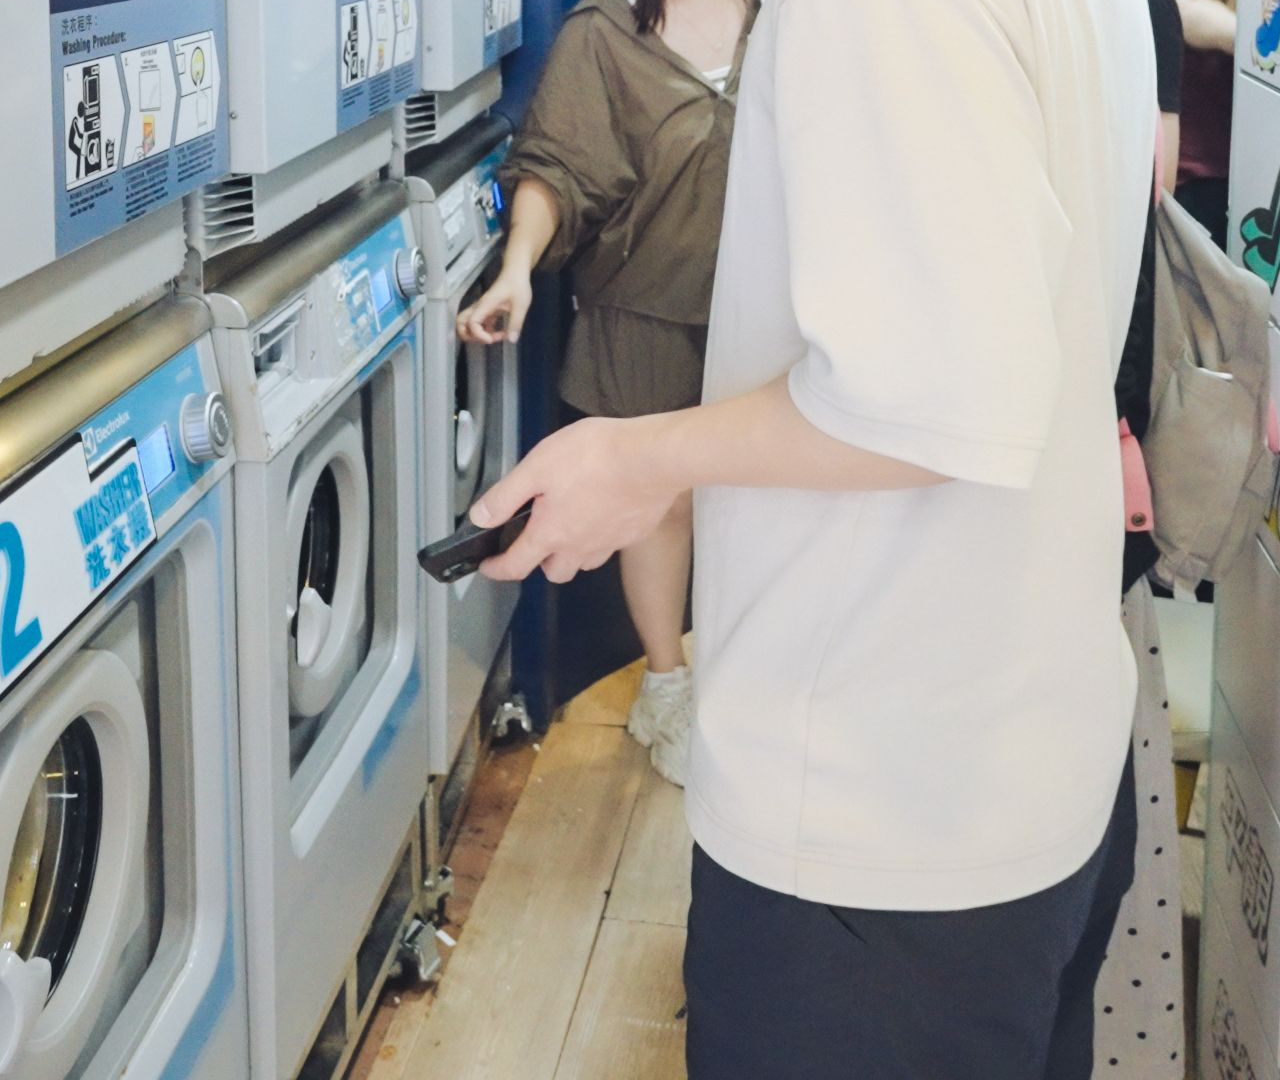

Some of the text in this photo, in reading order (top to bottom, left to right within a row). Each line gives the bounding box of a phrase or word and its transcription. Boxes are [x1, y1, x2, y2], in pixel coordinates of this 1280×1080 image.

[61, 32, 91, 58] Washing
[96, 410, 131, 444] Electrolux
[72, 460, 144, 550] WASHER
[84, 500, 152, 592] 洗衣機
